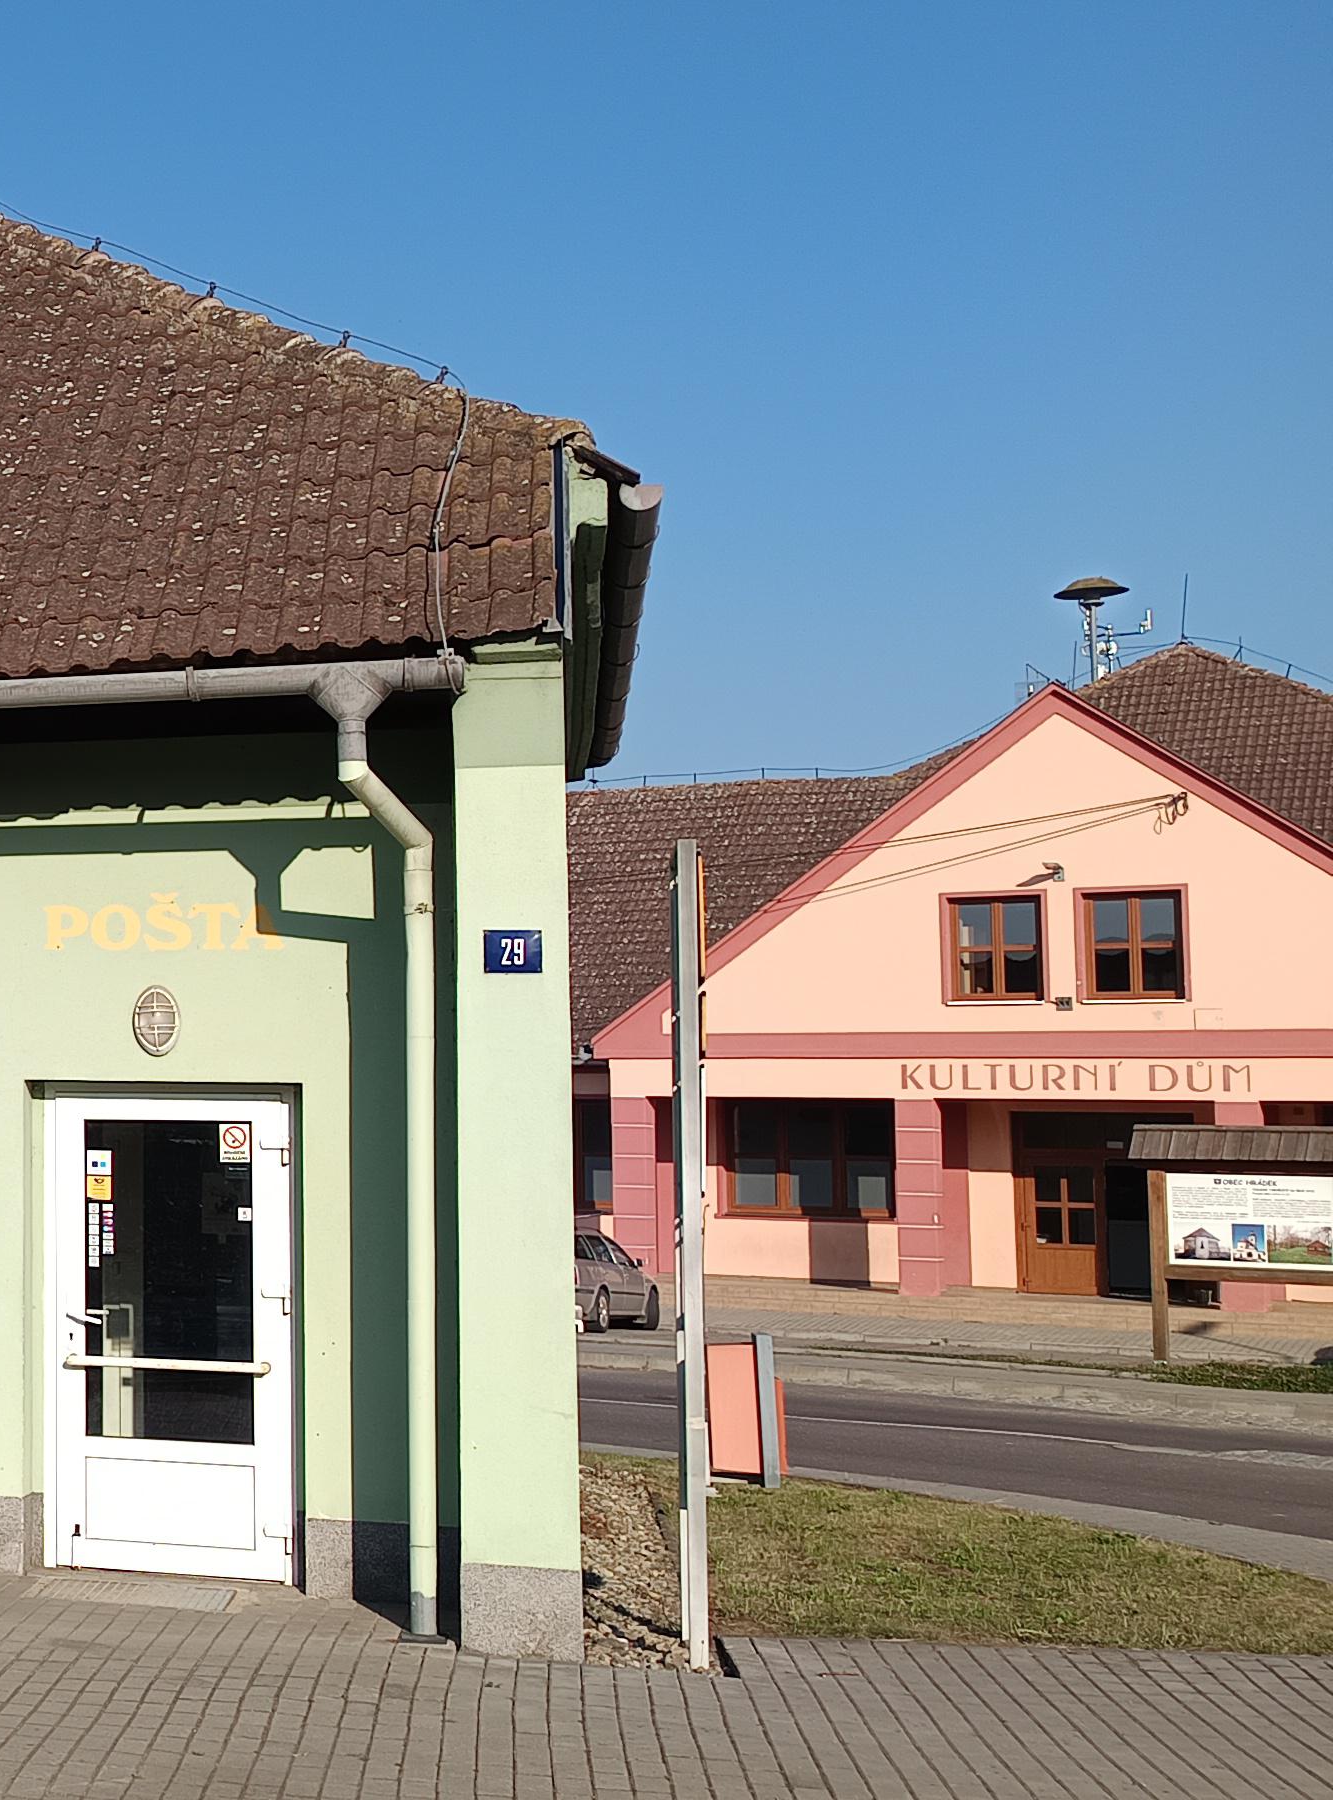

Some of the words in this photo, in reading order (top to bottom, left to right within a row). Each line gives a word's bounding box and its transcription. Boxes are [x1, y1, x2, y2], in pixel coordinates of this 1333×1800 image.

[42, 890, 286, 952] POŠTA
[500, 938, 525, 966] 29
[900, 1060, 1123, 1092] KULTURNÍ
[1148, 1060, 1251, 1093] DŮM
[1222, 1178, 1243, 1186] OBEC
